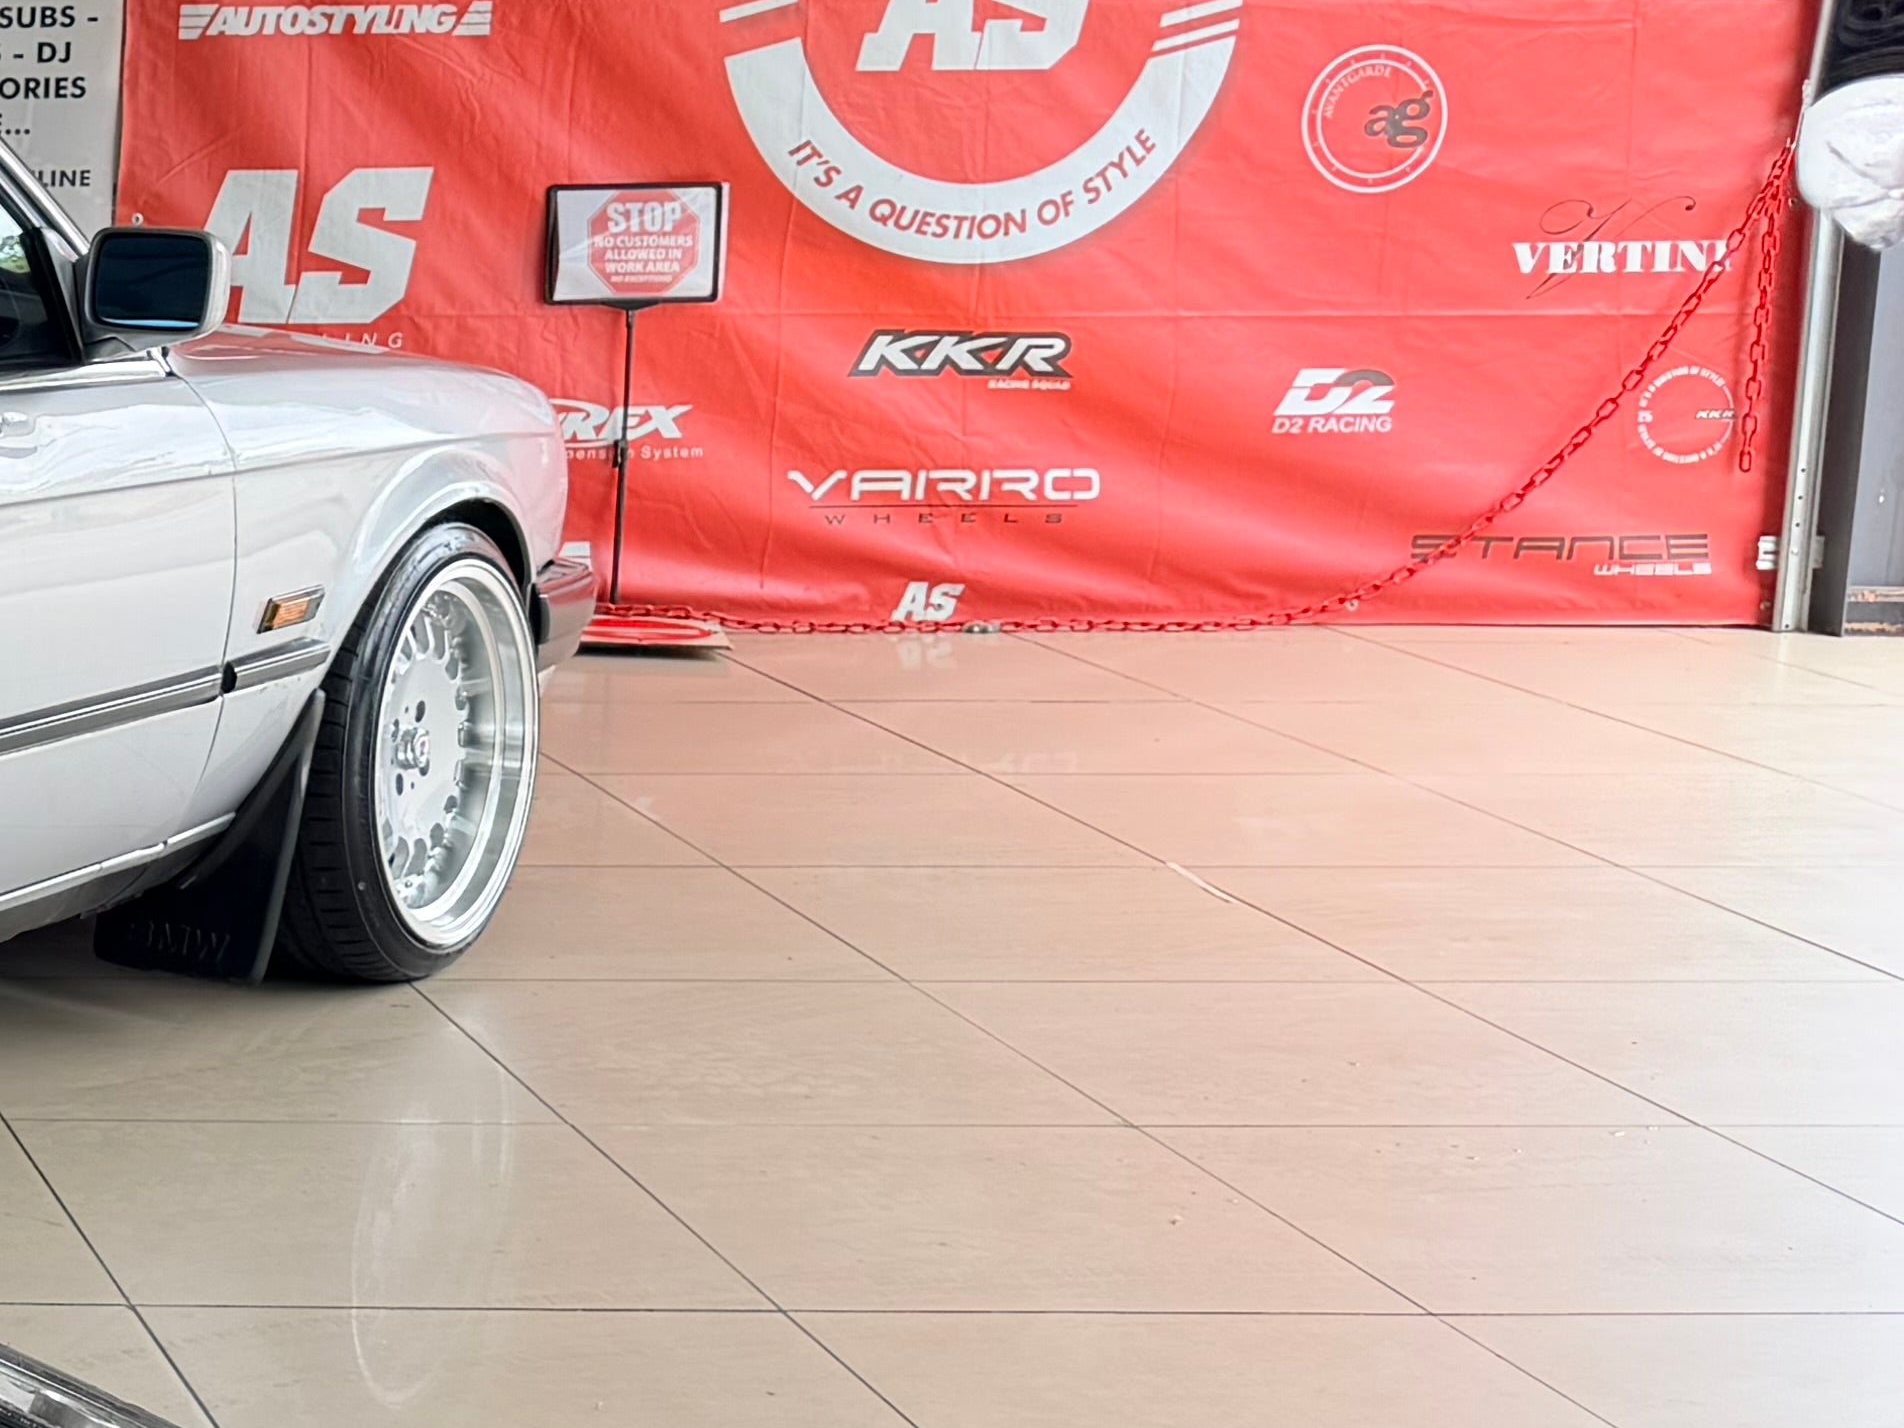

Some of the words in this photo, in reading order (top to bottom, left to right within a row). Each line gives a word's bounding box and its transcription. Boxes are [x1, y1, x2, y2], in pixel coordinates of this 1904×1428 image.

[37, 42, 71, 63] DJ
[787, 138, 840, 188] IT'S
[836, 182, 863, 209] A
[867, 197, 1027, 240] QUESTION
[1036, 194, 1076, 228] OF
[1071, 128, 1157, 205] STYLE
[607, 202, 681, 233] STOP
[594, 236, 613, 246] NO
[617, 235, 693, 246] CUSTOMERS
[605, 249, 665, 260] ALLOWED
[668, 249, 681, 260] IN
[606, 262, 642, 273] WORK
[646, 262, 680, 273] AREA
[641, 446, 704, 461] System
